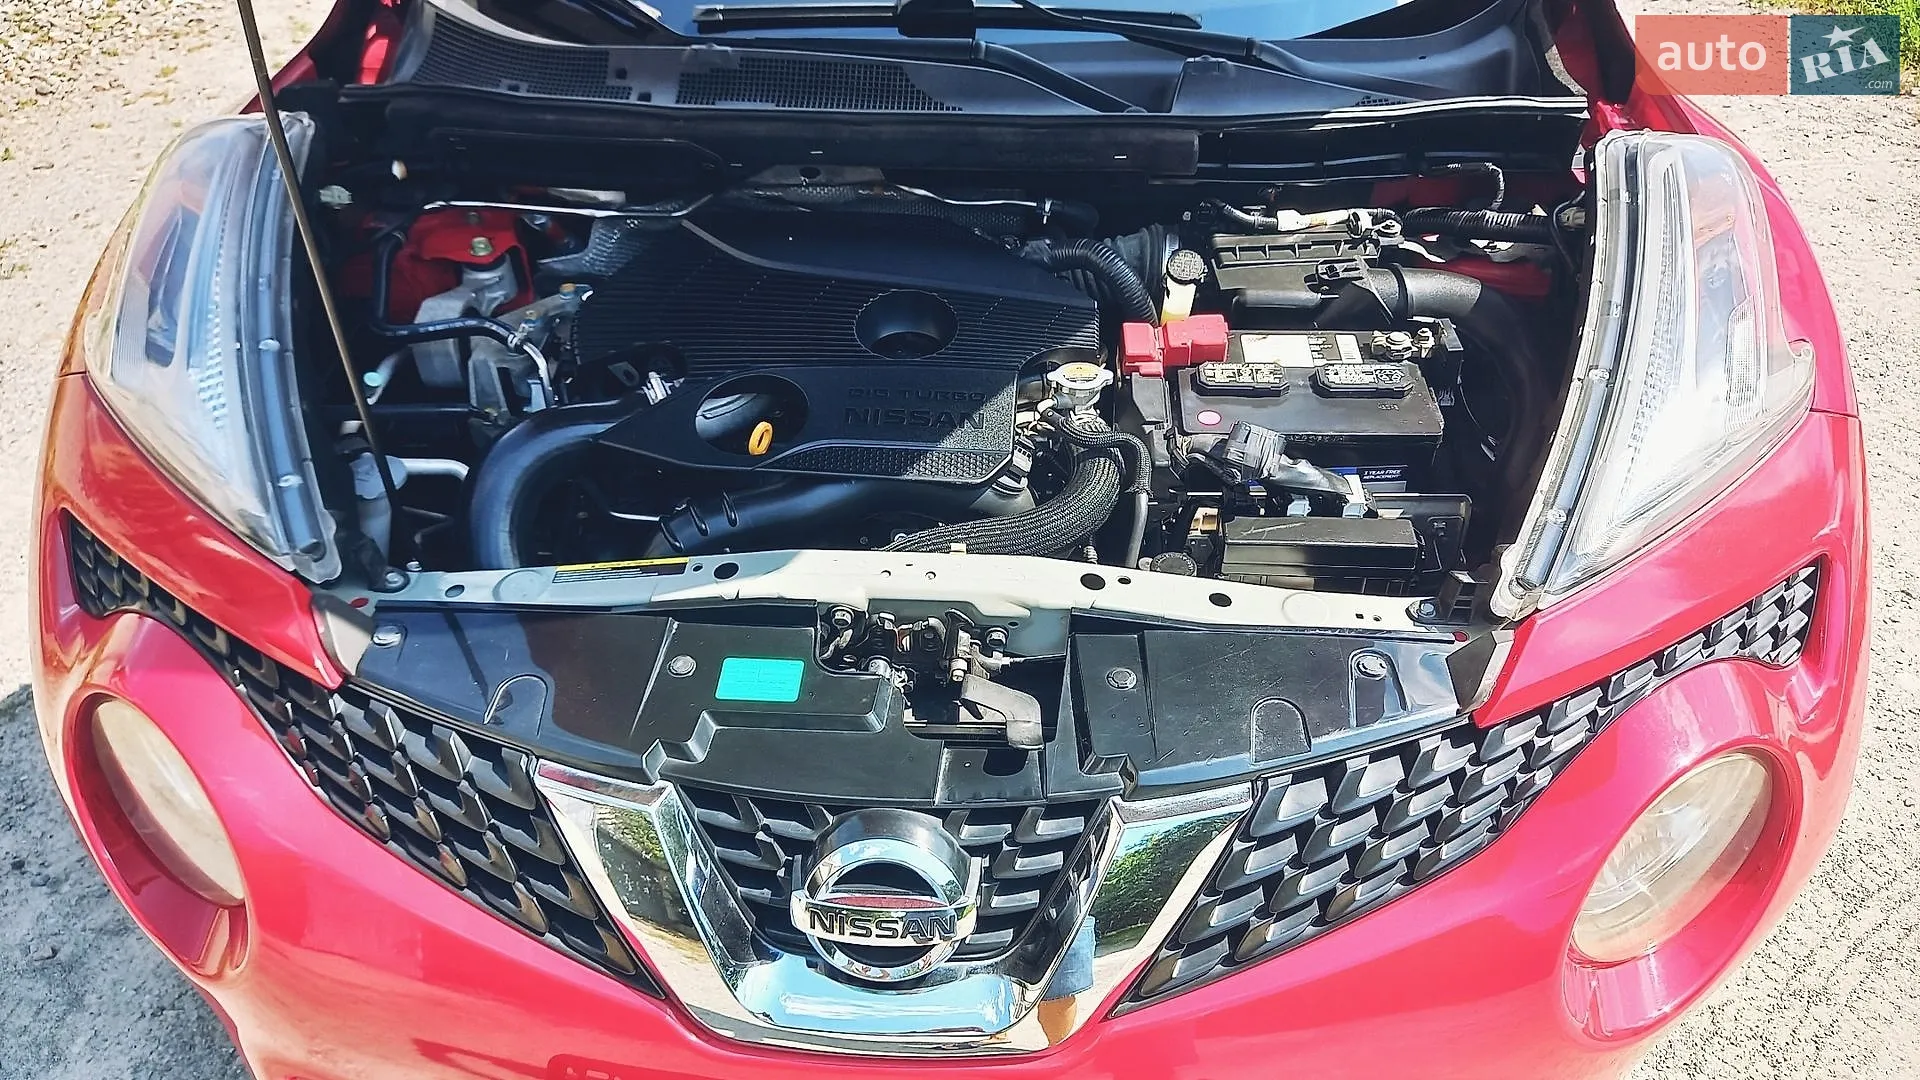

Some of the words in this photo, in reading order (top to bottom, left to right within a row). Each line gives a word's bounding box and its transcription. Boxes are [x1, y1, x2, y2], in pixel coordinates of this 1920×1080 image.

[897, 388, 988, 401] TURBO
[844, 407, 986, 430] NISSAN
[808, 907, 957, 943] NISSAN
